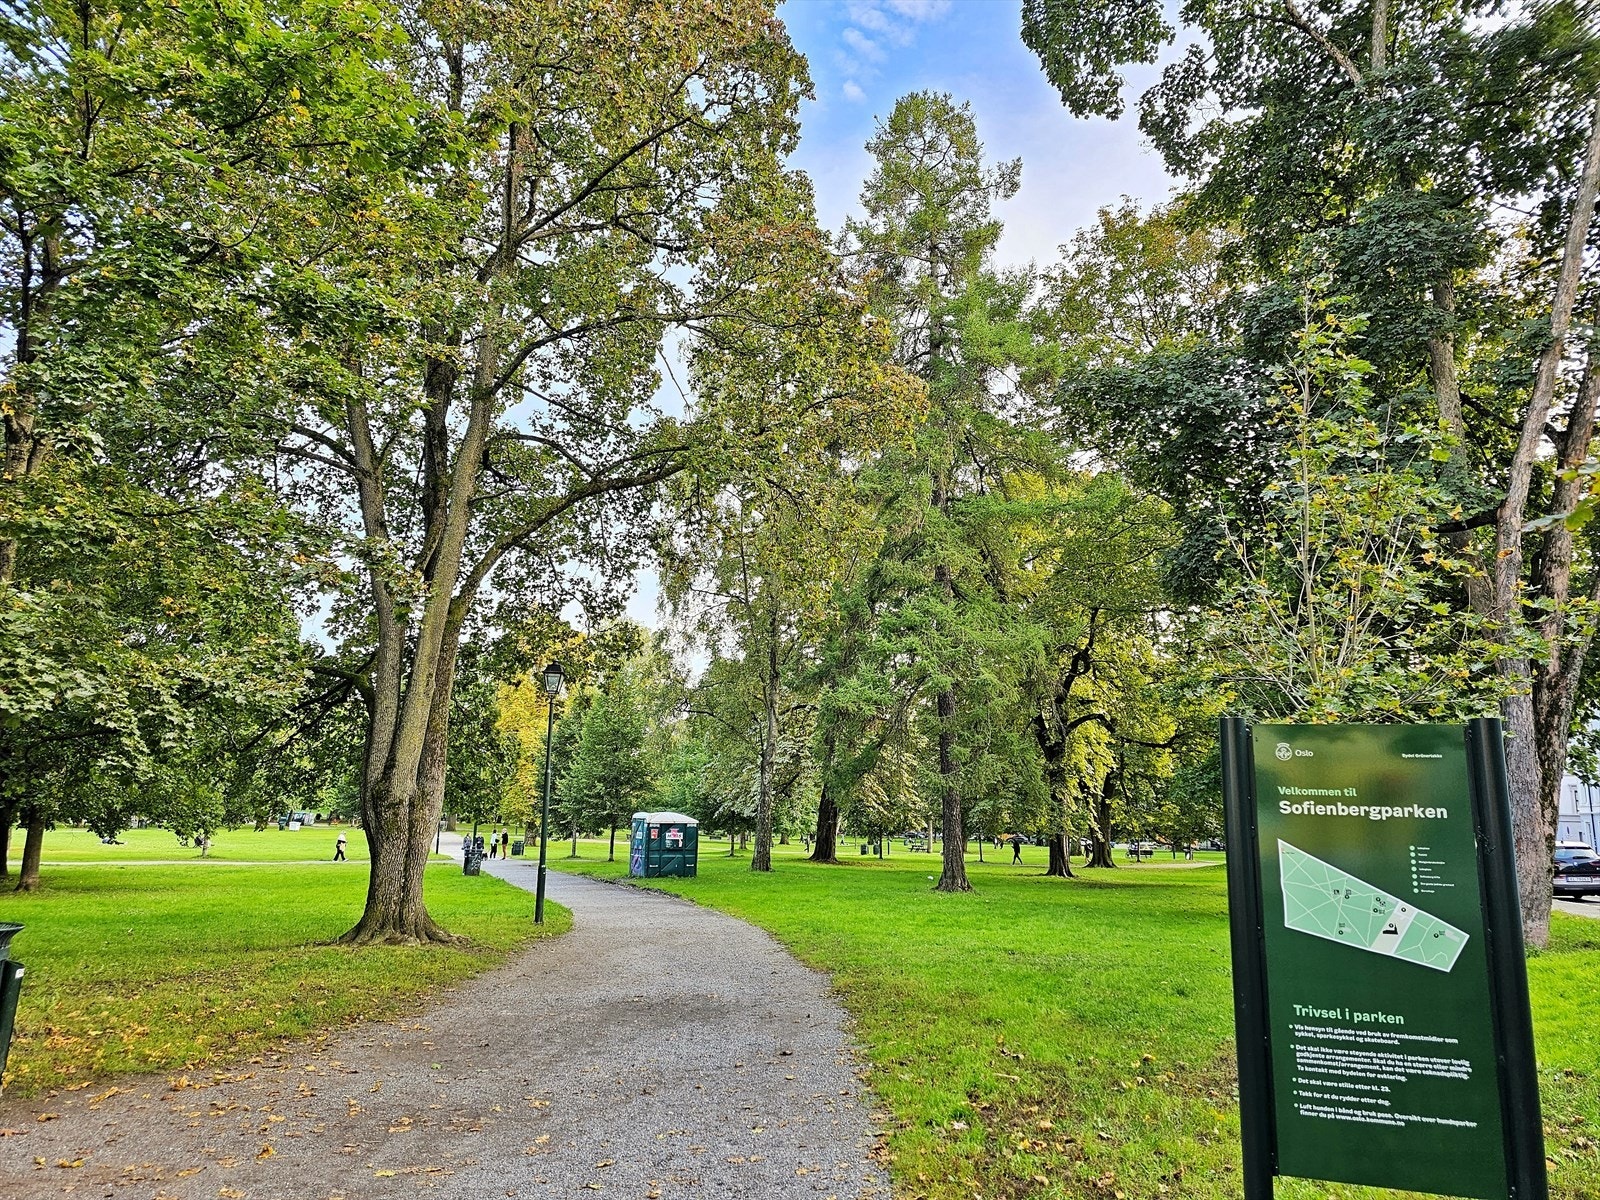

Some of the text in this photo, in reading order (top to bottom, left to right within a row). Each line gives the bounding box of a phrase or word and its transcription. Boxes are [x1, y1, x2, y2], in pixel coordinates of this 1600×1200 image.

[1295, 749, 1314, 757] Oslo
[1277, 786, 1357, 797] Velkommen til
[1278, 800, 1448, 820] Sofienbergparken
[1293, 1004, 1404, 1024] Trivsel i parken
[1390, 1032, 1444, 1042] fremkomstmidler
[1326, 1054, 1371, 1063] arrangementer.
[1394, 1113, 1421, 1122] Oversikt
